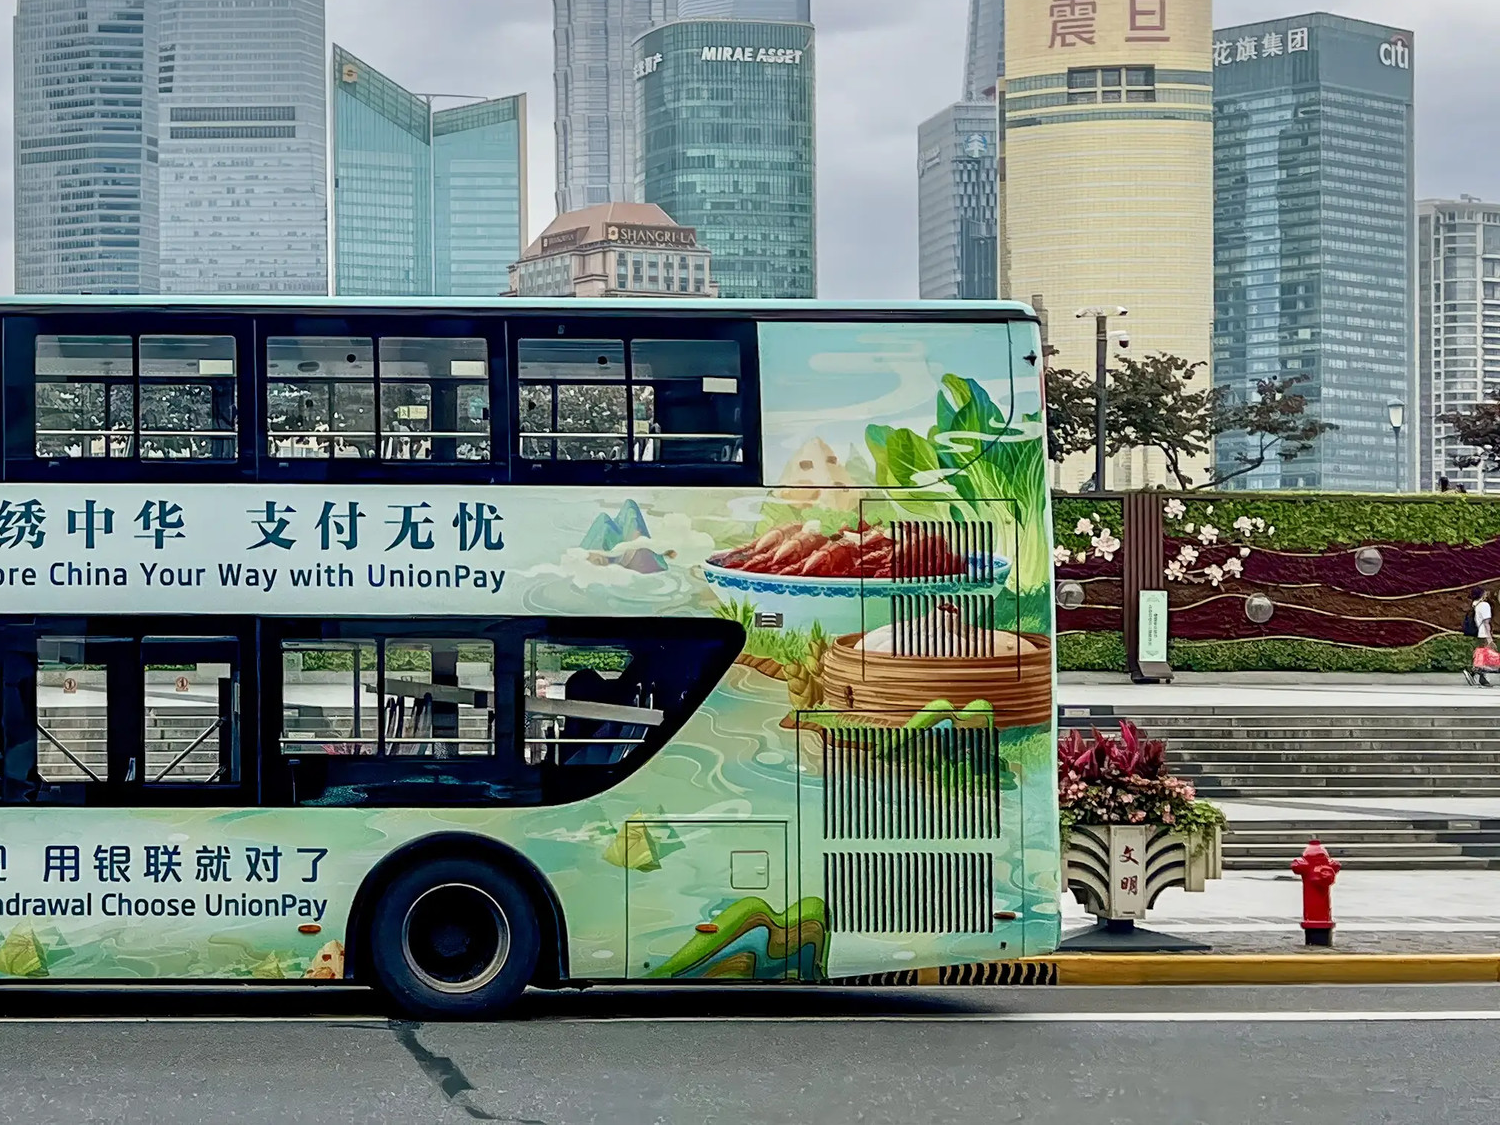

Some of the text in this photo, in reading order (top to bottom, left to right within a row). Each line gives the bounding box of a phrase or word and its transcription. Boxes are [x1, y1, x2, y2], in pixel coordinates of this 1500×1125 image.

[700, 46, 803, 65] MIRAE ASSET
[1213, 27, 1309, 68] 花旗集团
[1379, 39, 1409, 70] citi
[245, 500, 505, 552] 支付无忧
[49, 562, 128, 587] China
[139, 563, 206, 587] Your
[218, 563, 278, 593] Way
[289, 563, 354, 587] with
[367, 564, 506, 594] UnionPay
[43, 844, 329, 883] 用银联就对了
[1119, 845, 1139, 896] 文明
[101, 892, 196, 917] Choose
[204, 892, 328, 922] UnionPay
